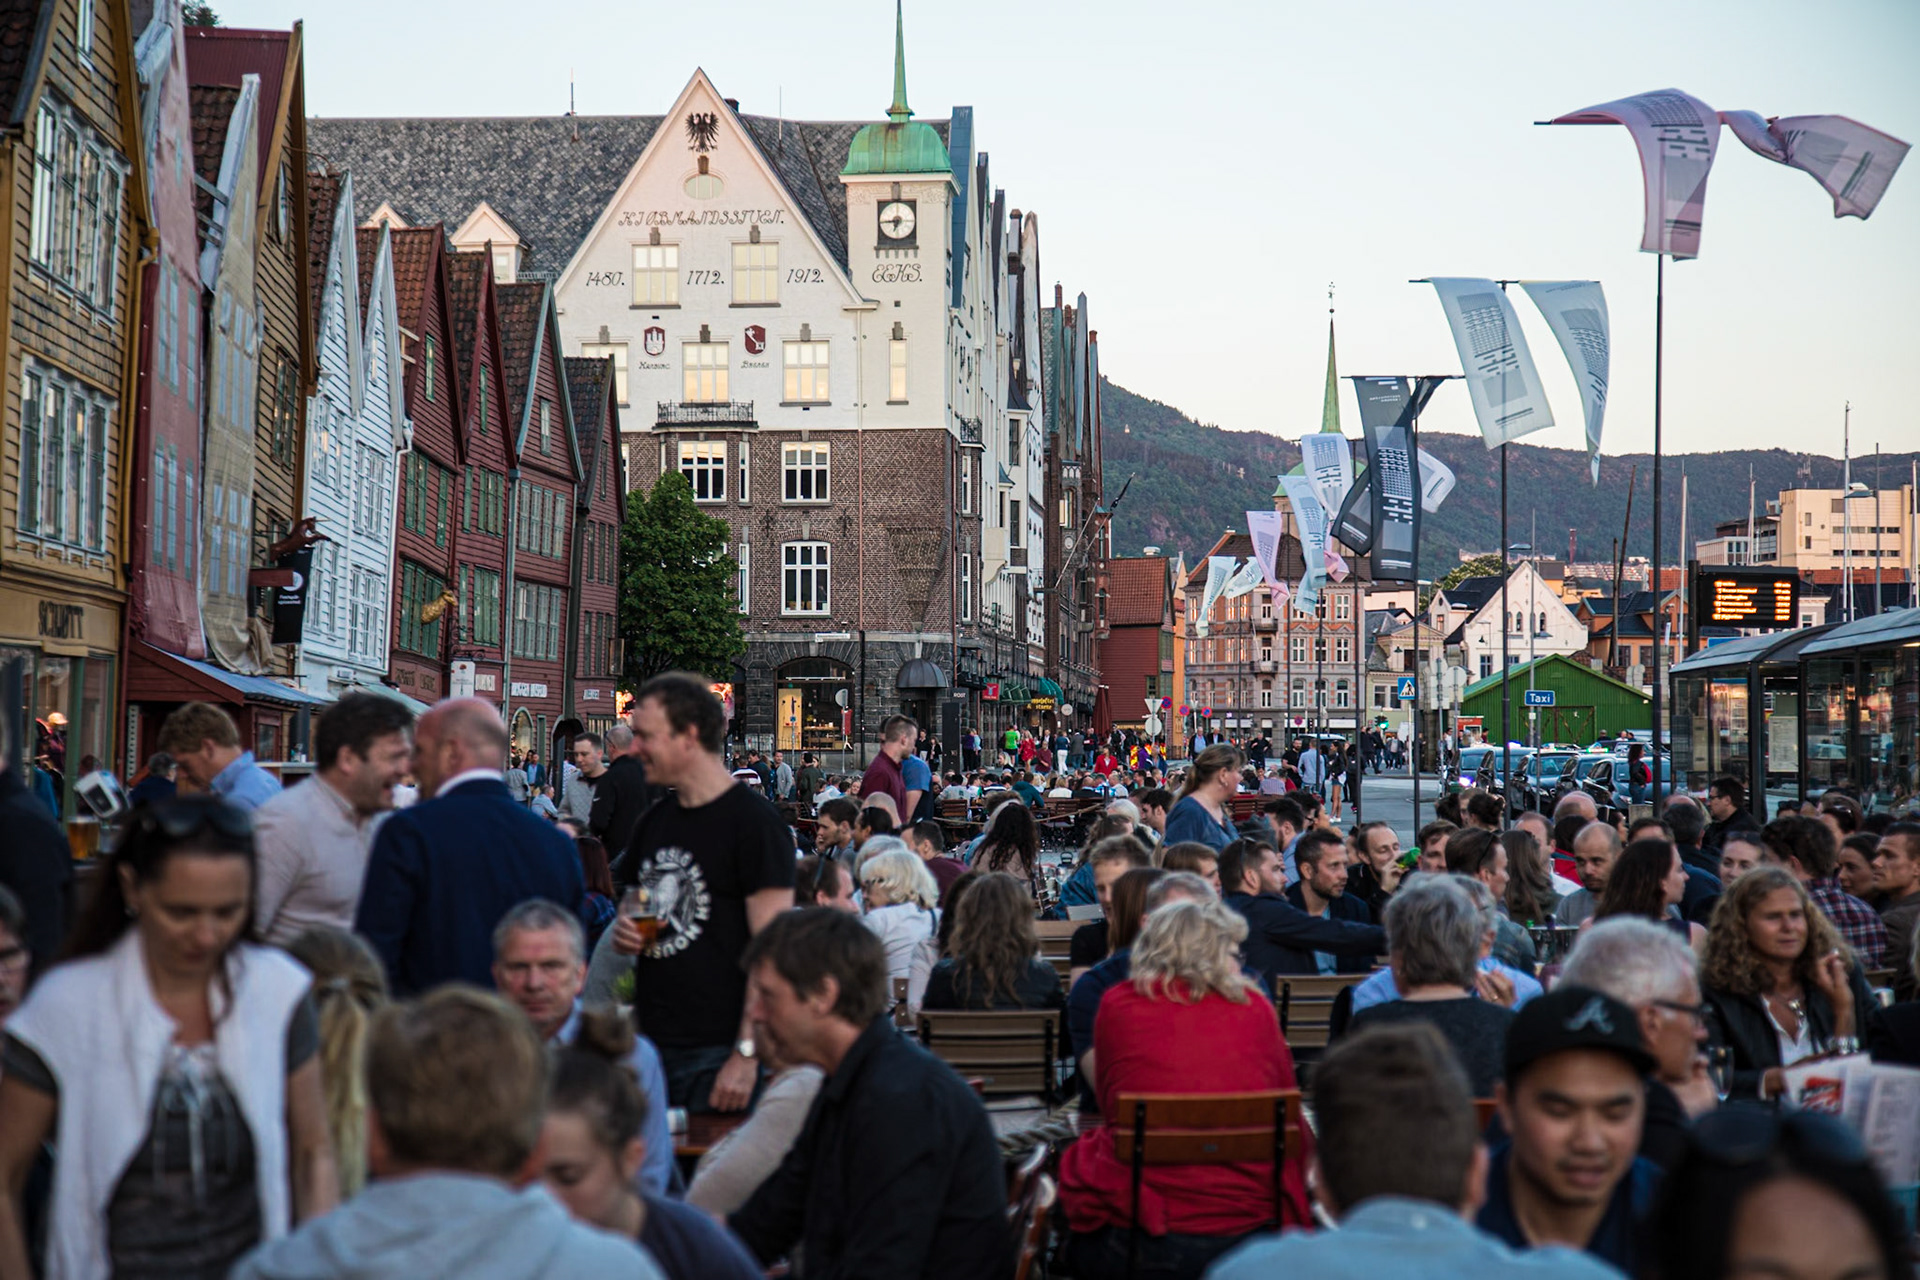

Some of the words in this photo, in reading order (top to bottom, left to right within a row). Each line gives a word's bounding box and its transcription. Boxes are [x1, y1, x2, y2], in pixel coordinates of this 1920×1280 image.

[586, 271, 625, 286] 1480.
[687, 270, 725, 285] 1712.
[786, 268, 824, 283] 1912.
[1530, 693, 1551, 703] Taxi
